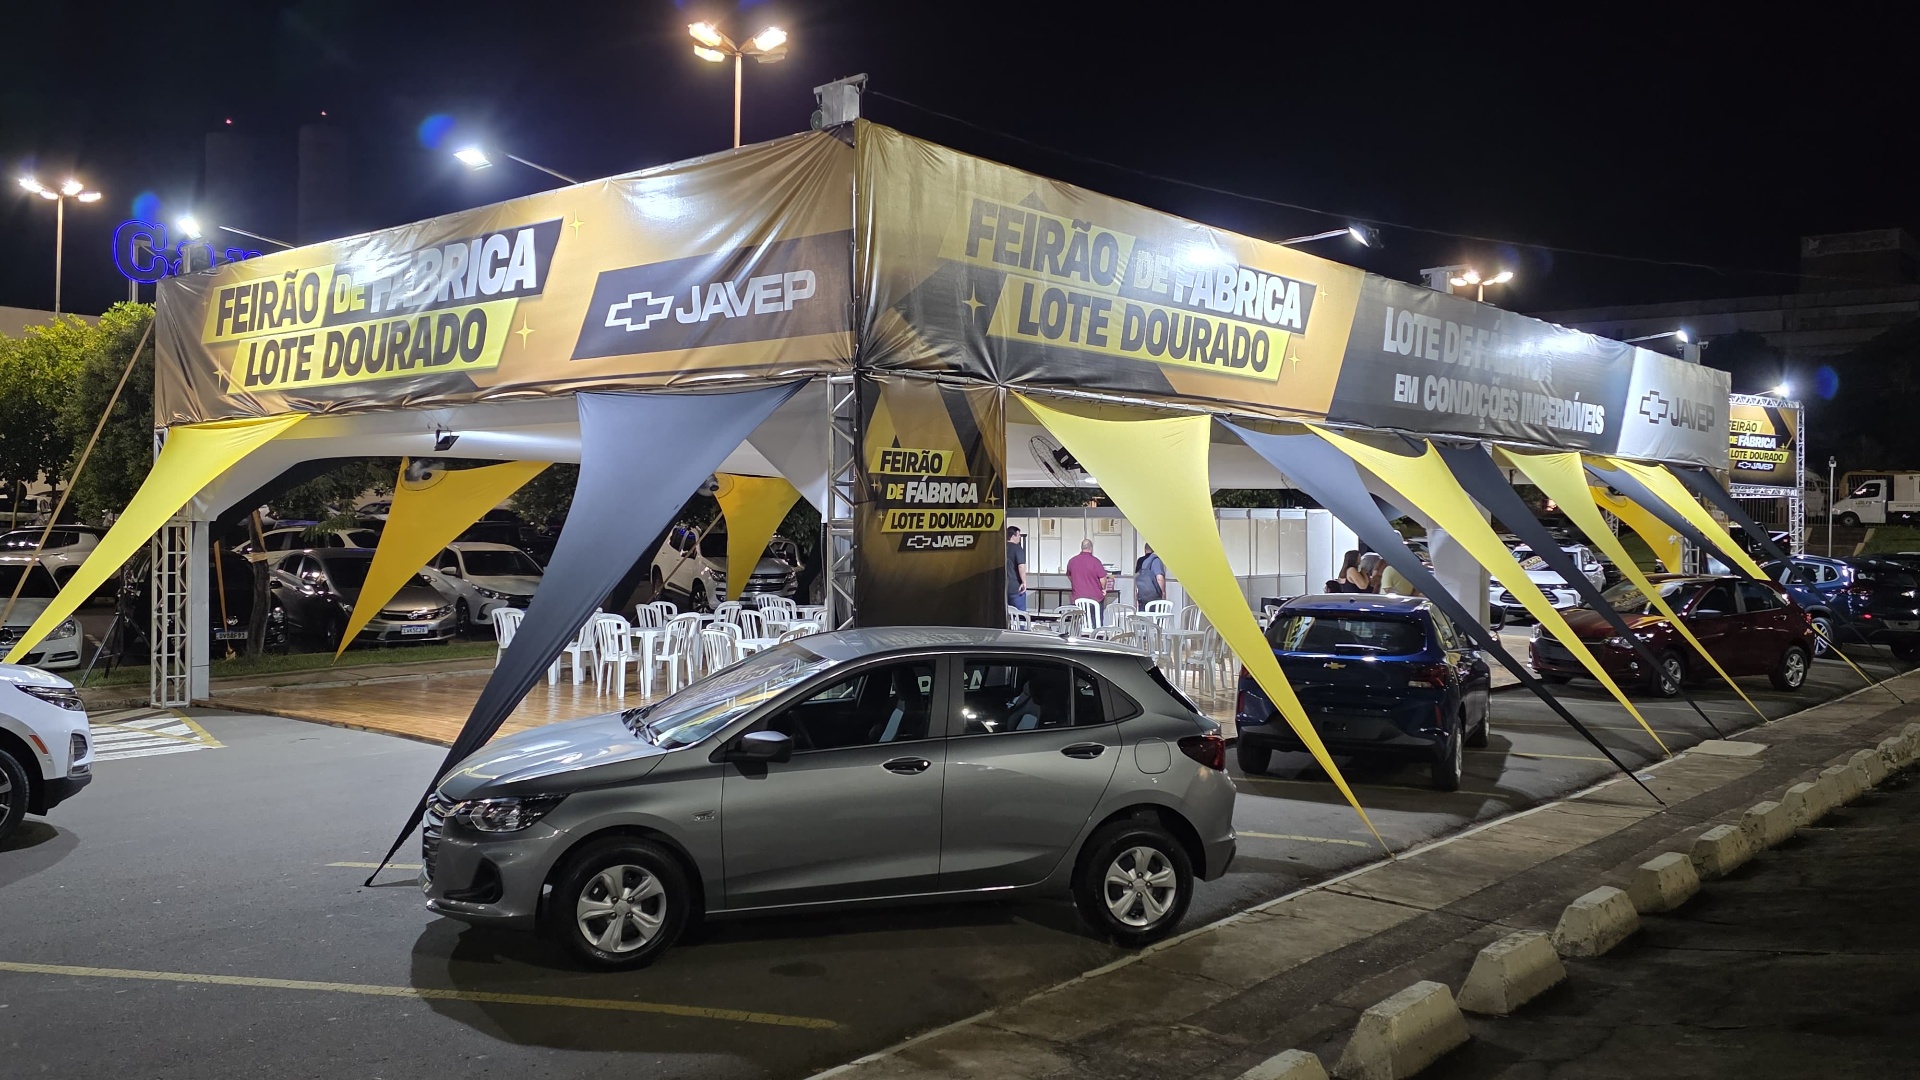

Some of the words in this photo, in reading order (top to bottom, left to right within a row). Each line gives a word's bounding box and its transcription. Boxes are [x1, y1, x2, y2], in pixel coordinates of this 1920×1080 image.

[965, 198, 1119, 287] FEIRÃO
[1132, 249, 1171, 295] DE
[216, 269, 319, 337] FEIRÃO
[333, 268, 365, 315] DE
[369, 228, 537, 314] FÁBRICA
[675, 270, 816, 324] JAVEP
[244, 332, 316, 387] LOTE
[322, 310, 488, 378] DOURADO
[1017, 282, 1112, 348] LOTE
[1120, 308, 1270, 373] DOURADO
[1383, 306, 1441, 361] LOTE
[1443, 320, 1474, 367] DE
[1394, 373, 1419, 404] EM
[1424, 374, 1519, 430] CONDIÇÕES
[1520, 391, 1605, 435] IMPERDÍVEIS
[1670, 397, 1716, 433] JAVEP
[880, 450, 943, 474] FEIRÃO
[1730, 449, 1748, 459] LOTE
[1749, 451, 1784, 462] DOURADO
[1738, 432, 1777, 449] FÁBRICA
[886, 483, 905, 500] DE
[905, 475, 979, 504] FÁBRICA
[890, 512, 925, 530] LOTE
[928, 512, 995, 529] DOURADO
[932, 534, 974, 548] JAVEP
